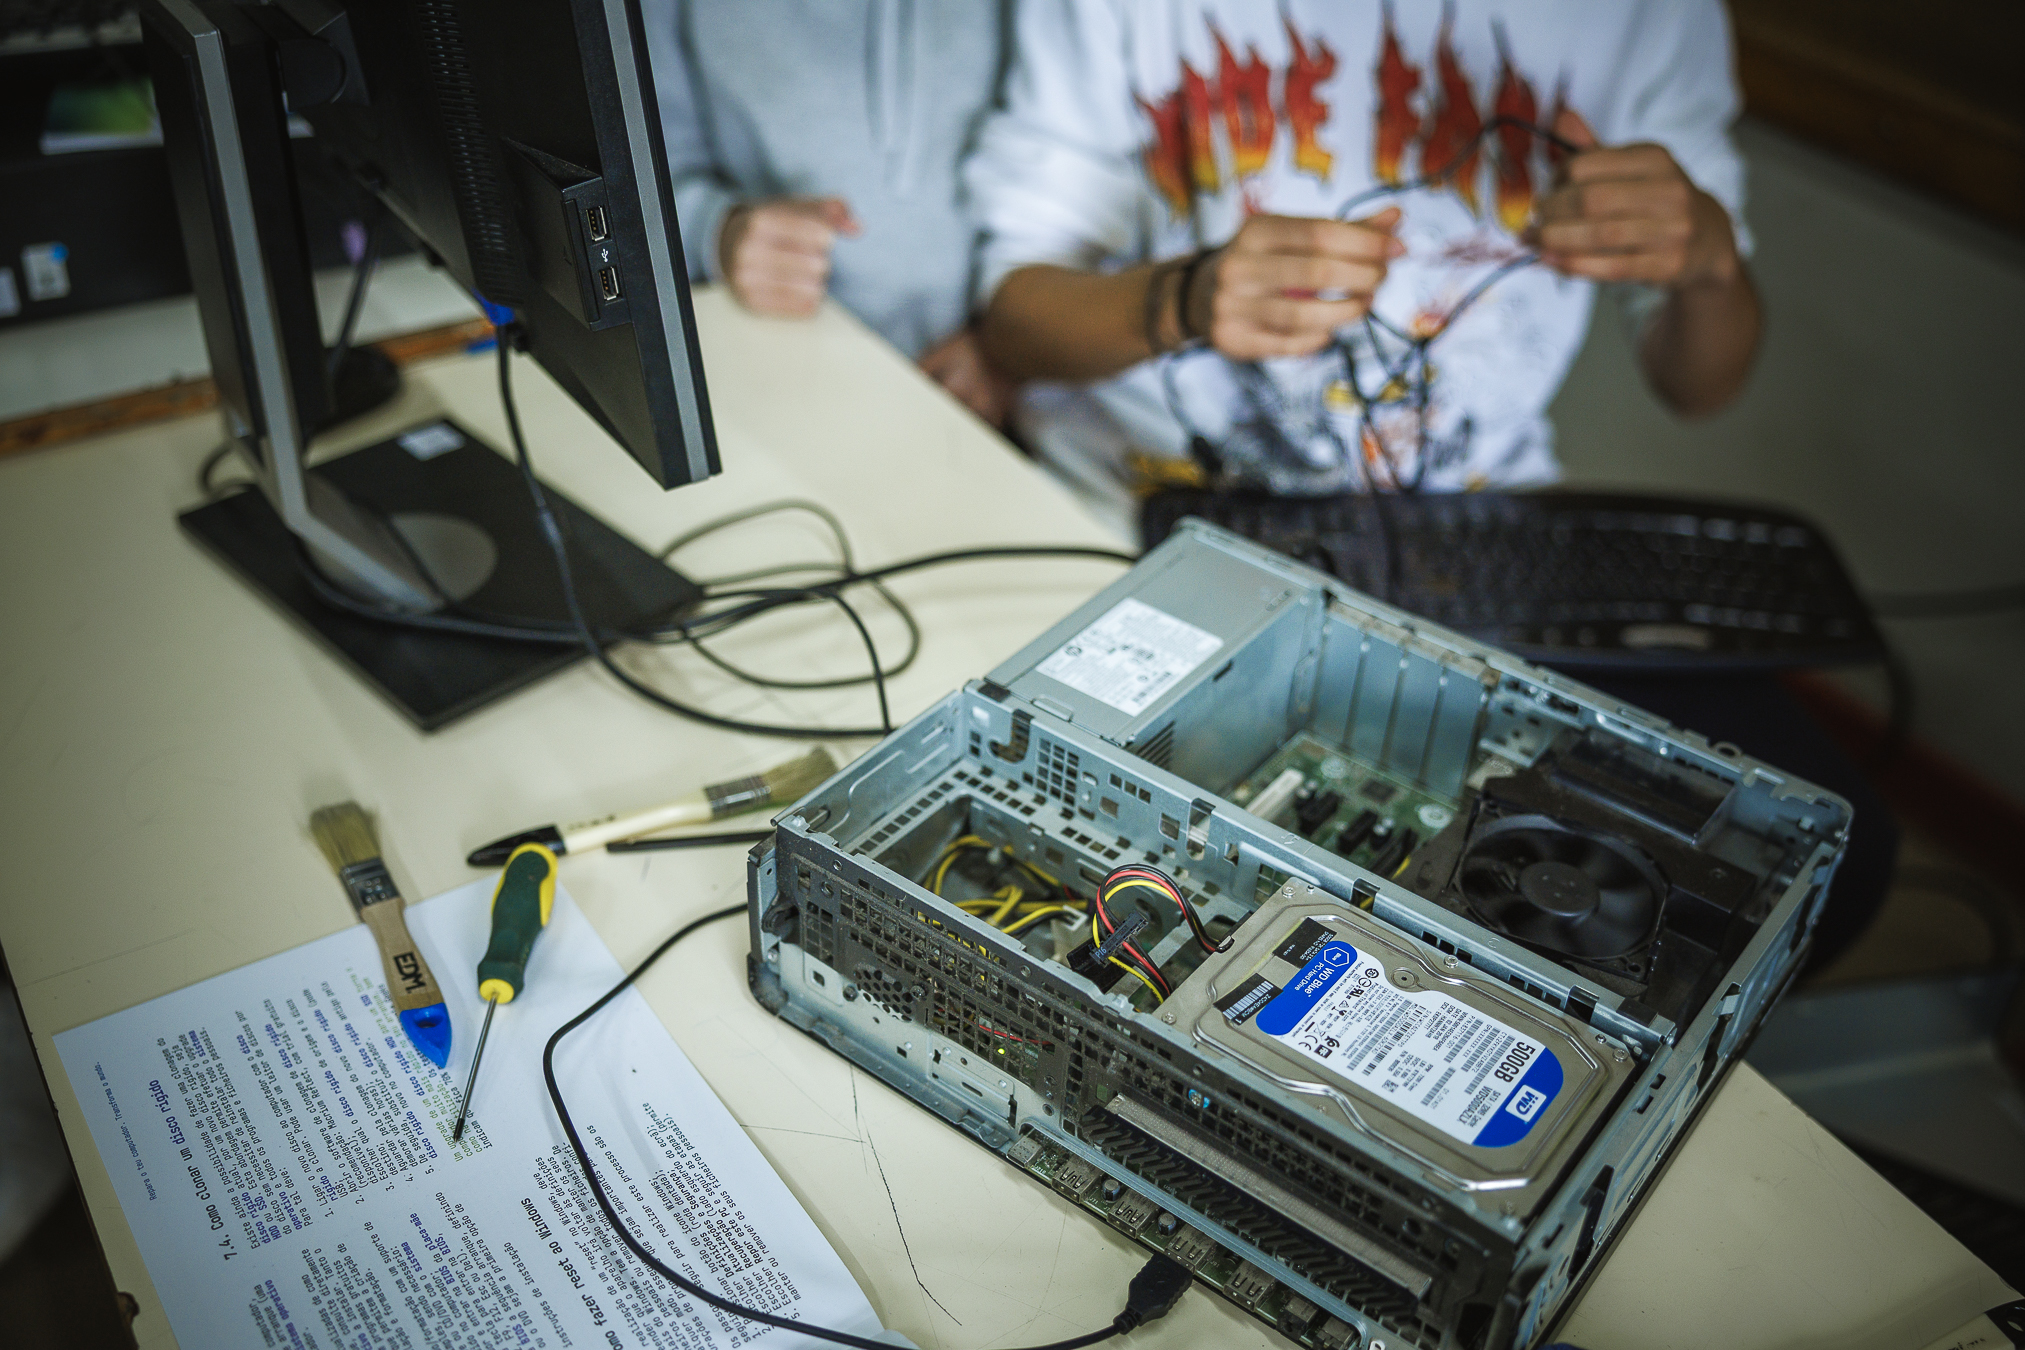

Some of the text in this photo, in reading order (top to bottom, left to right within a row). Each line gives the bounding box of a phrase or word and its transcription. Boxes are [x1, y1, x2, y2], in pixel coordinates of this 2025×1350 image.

[393, 952, 426, 993] EDM
[1094, 946, 1106, 958] P16
[1294, 962, 1324, 990] PC Hard Drive
[1303, 967, 1334, 994] WD Blue
[1331, 952, 1341, 960] Blue
[420, 1075, 447, 1114] muito mais
[1487, 1090, 1500, 1102] SATA
[1492, 1041, 1536, 1083] 500GB
[188, 1029, 286, 1222] disco necessitar reinstalar sistema
[195, 1069, 247, 1168] abordagem permite efetuar
[236, 1034, 327, 1206] Ligar novo disco computador disco
[260, 1059, 337, 1201] rígido Pode usar leitor
[265, 1022, 358, 1193] Abrir software clonagem disco rígido
[299, 1065, 370, 1189] (recomendação: Macrium Reflect,
[324, 1069, 388, 1180] Escolher qual disco rígido
[339, 1054, 408, 1171] Aguardar pela clonagem novo
[375, 1076, 420, 1150] seguida, substituir
[382, 1110, 417, 1167] demorar várias
[395, 1091, 437, 1159] disco rígido novo
[408, 1075, 455, 1149] upgrade disco
[470, 1120, 491, 1149] indicam
[1512, 1091, 1538, 1116] WD
[148, 1078, 237, 1259] 7.4. Como clonar disco rígido
[184, 1096, 260, 1248] Existe ainda possibilidade fazer
[194, 1092, 271, 1244] disco rígido disco
[215, 1062, 302, 1230] operativo todos programas ficheiros
[347, 1133, 378, 1184] disponível);
[375, 1140, 398, 1176] destino;
[467, 1135, 482, 1152] como
[298, 1206, 312, 1226] Para
[533, 1172, 571, 1225] Windows, deve
[535, 1156, 626, 1290] aparelho voltar definições
[547, 1156, 628, 1273] Tem opção manter seus
[594, 1135, 685, 1258] para realizar este processo são
[595, 1208, 613, 1231] todos
[649, 1175, 718, 1273] botão ícone Windows;
[656, 1168, 733, 1277] Definições (roda dentada);
[664, 1112, 800, 1299] manter remover seus ficheiros pessoais).
[666, 1134, 791, 1304] Escolher Repor este seguir etapas
[667, 1167, 743, 1272] Atualizações Segurança;
[318, 1255, 334, 1279] Tanto
[344, 1254, 364, 1285] criação
[370, 1233, 391, 1263] suporte
[410, 1212, 455, 1284] BIOS placa-mãe
[435, 1191, 510, 1312] sequência definindo
[435, 1231, 475, 1295] entrar BIOS,
[462, 1214, 503, 1272] primeira opção
[504, 1241, 534, 1285] instalação
[521, 1197, 607, 1326] fazer reset Windows
[673, 1160, 781, 1309] Escolher Recuperação (lado esquerdo
[301, 1248, 330, 1296] diretamente
[333, 1259, 360, 1299] gratuitos
[401, 1241, 453, 1328] CD/DVD sistema
[478, 1284, 490, 1300] Esc
